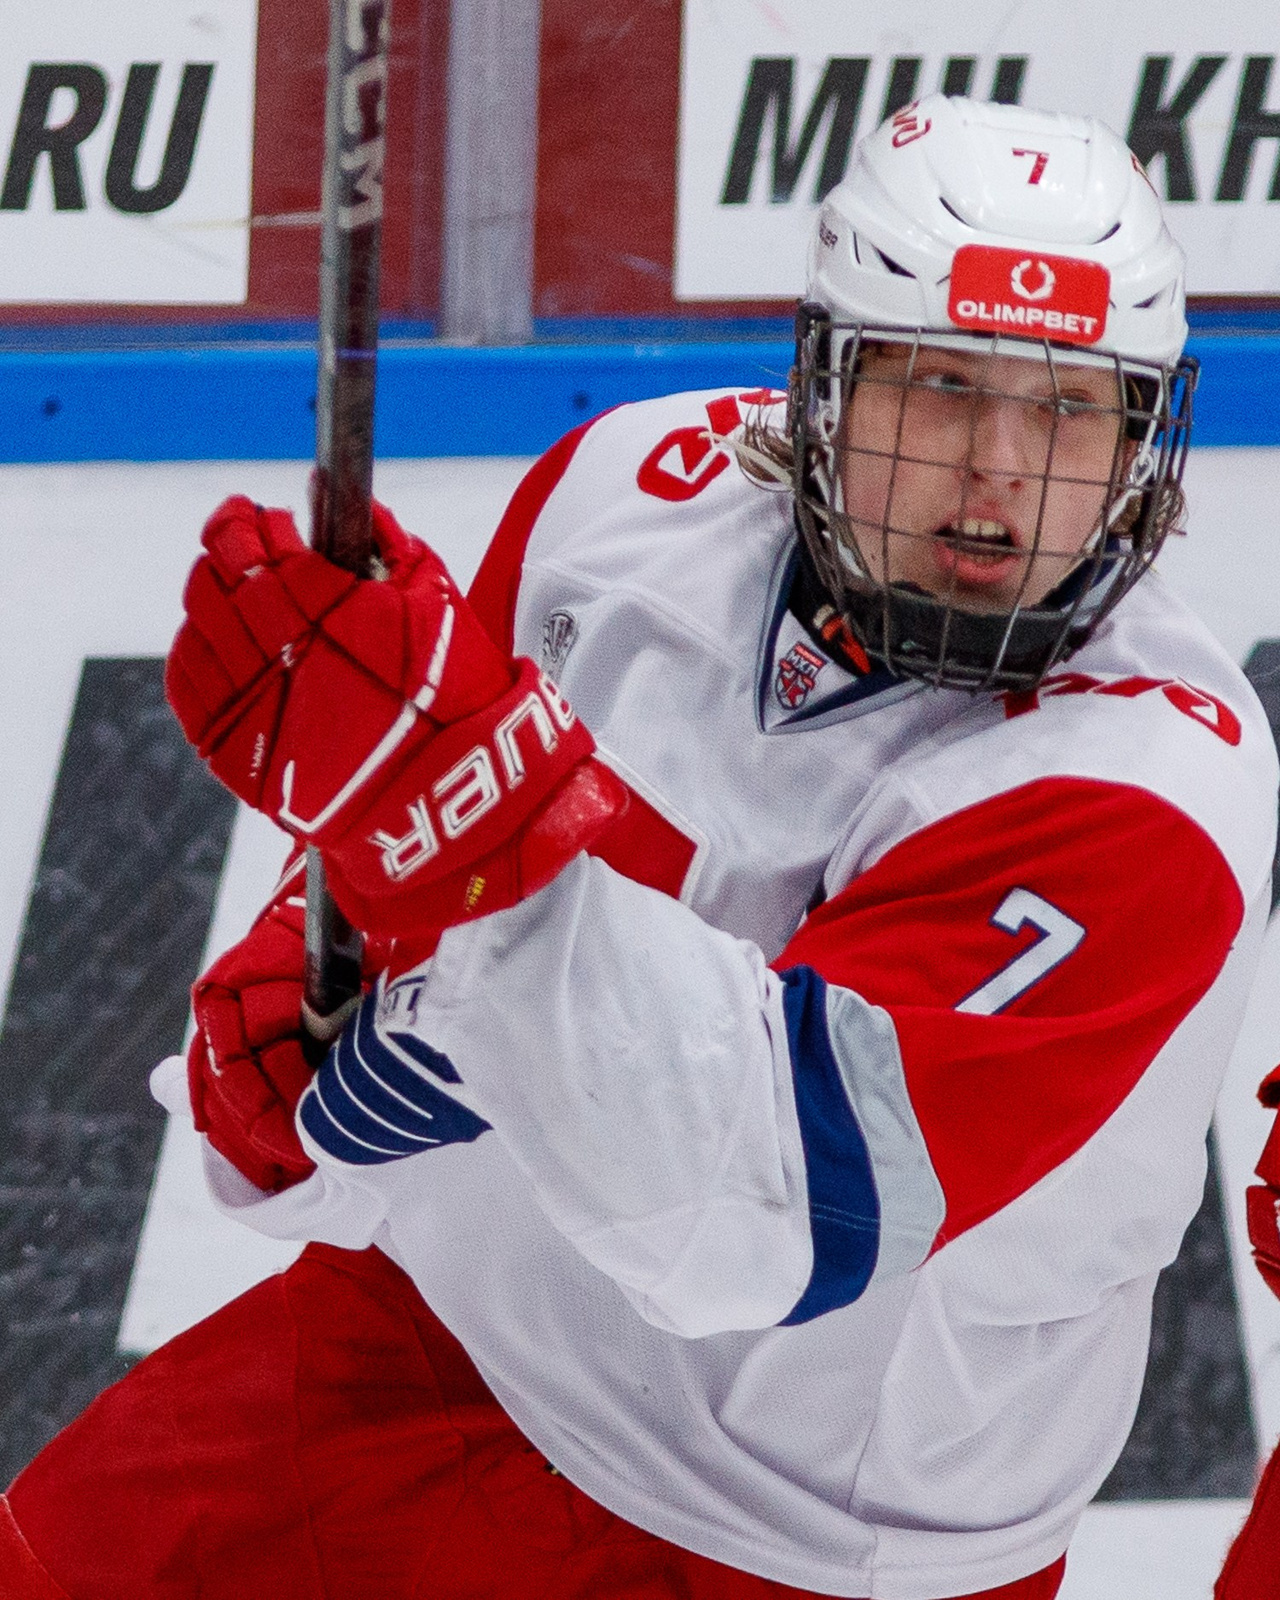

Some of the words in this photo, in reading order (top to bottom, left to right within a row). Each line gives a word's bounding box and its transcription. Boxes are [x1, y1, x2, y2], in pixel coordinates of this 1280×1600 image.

[1011, 147, 1050, 185] 7
[956, 299, 1098, 336] OLIMPBET
[365, 671, 578, 883] AUER
[953, 885, 1088, 1016] 7
